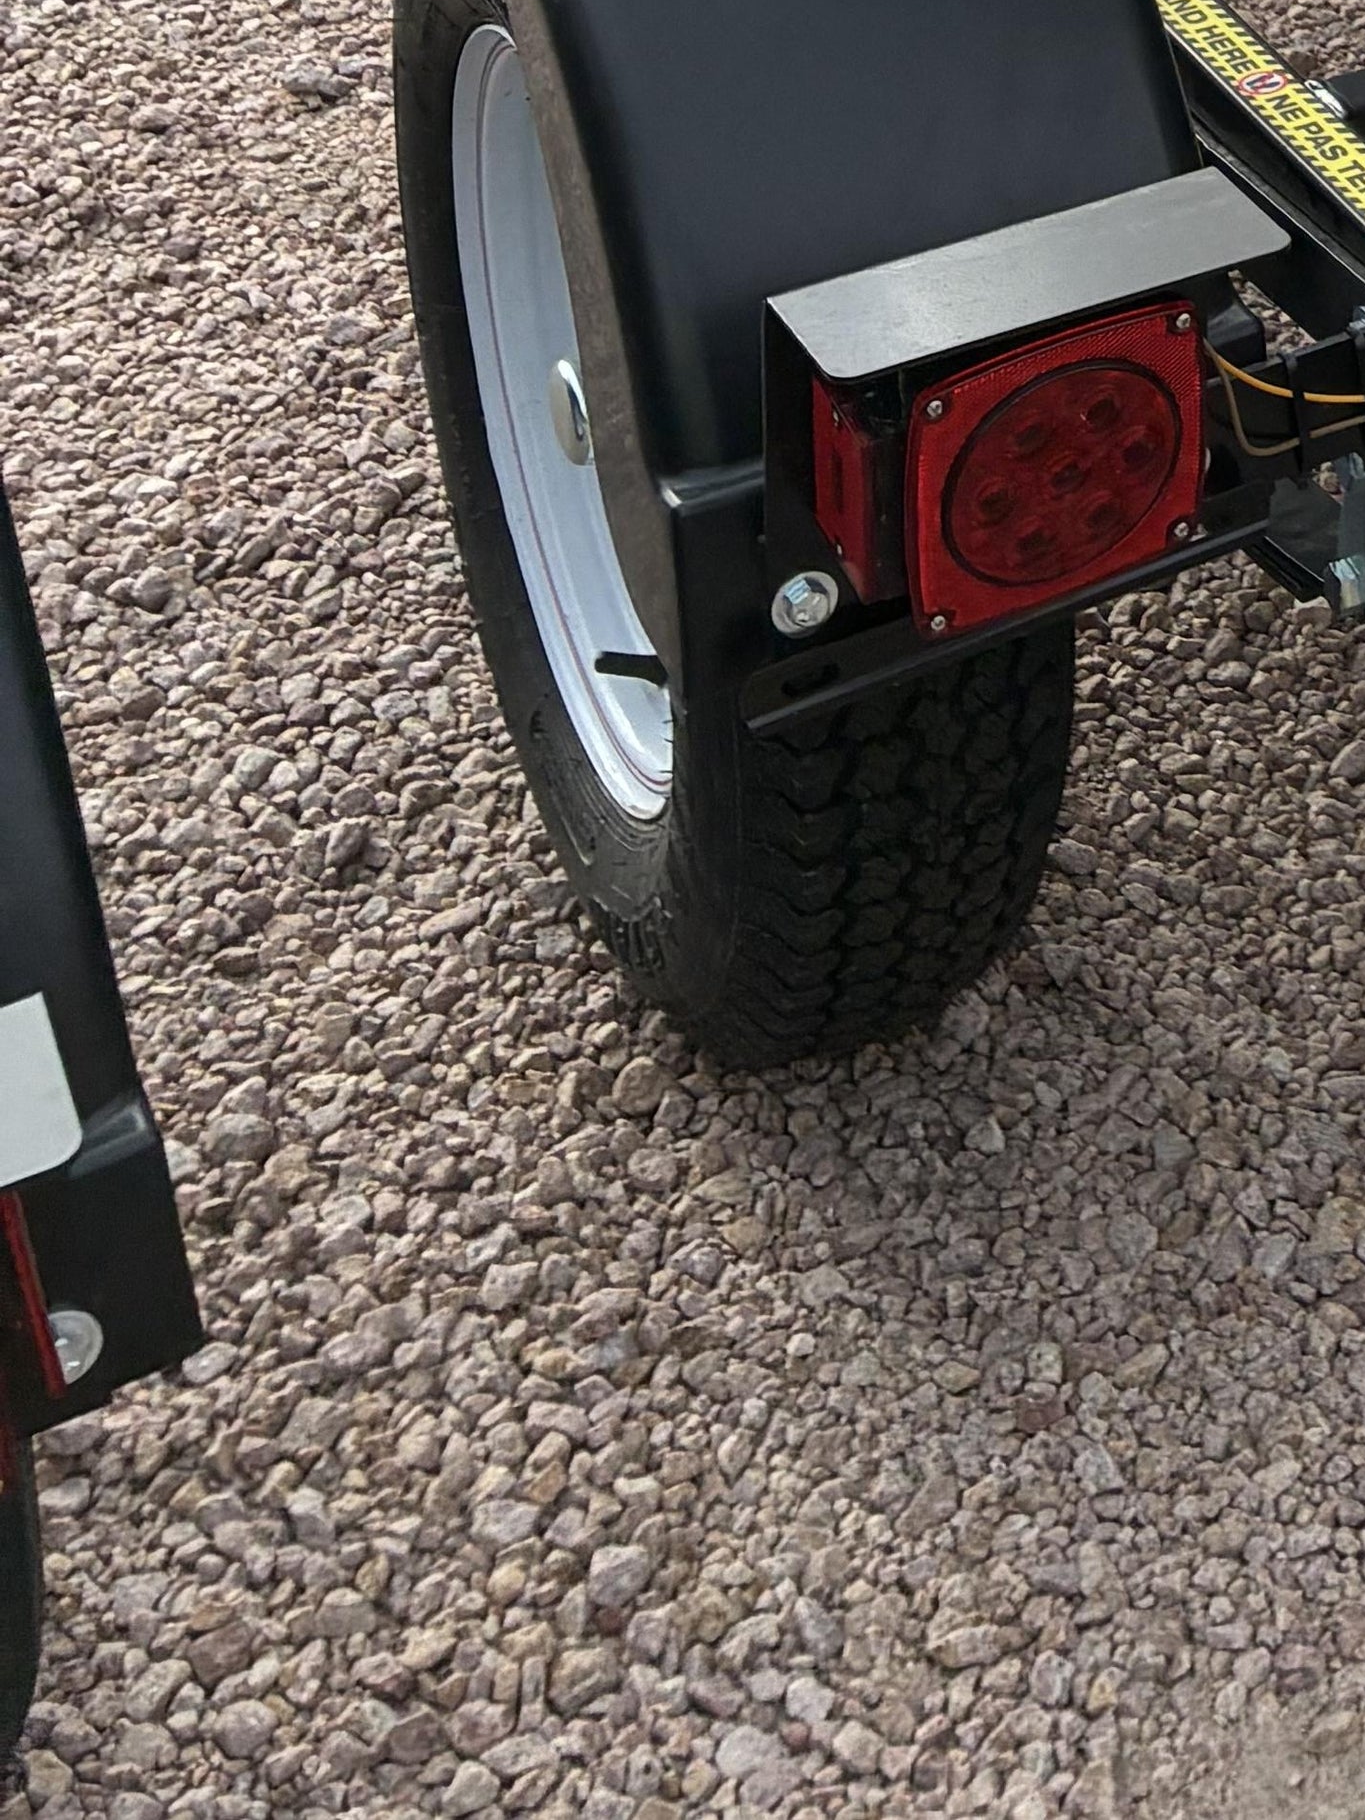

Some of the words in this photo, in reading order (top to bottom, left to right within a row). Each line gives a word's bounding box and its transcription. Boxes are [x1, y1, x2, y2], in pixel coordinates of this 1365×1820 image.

[1199, 23, 1262, 76] HERE
[1268, 94, 1304, 122] NE
[1294, 117, 1349, 162] PAS
